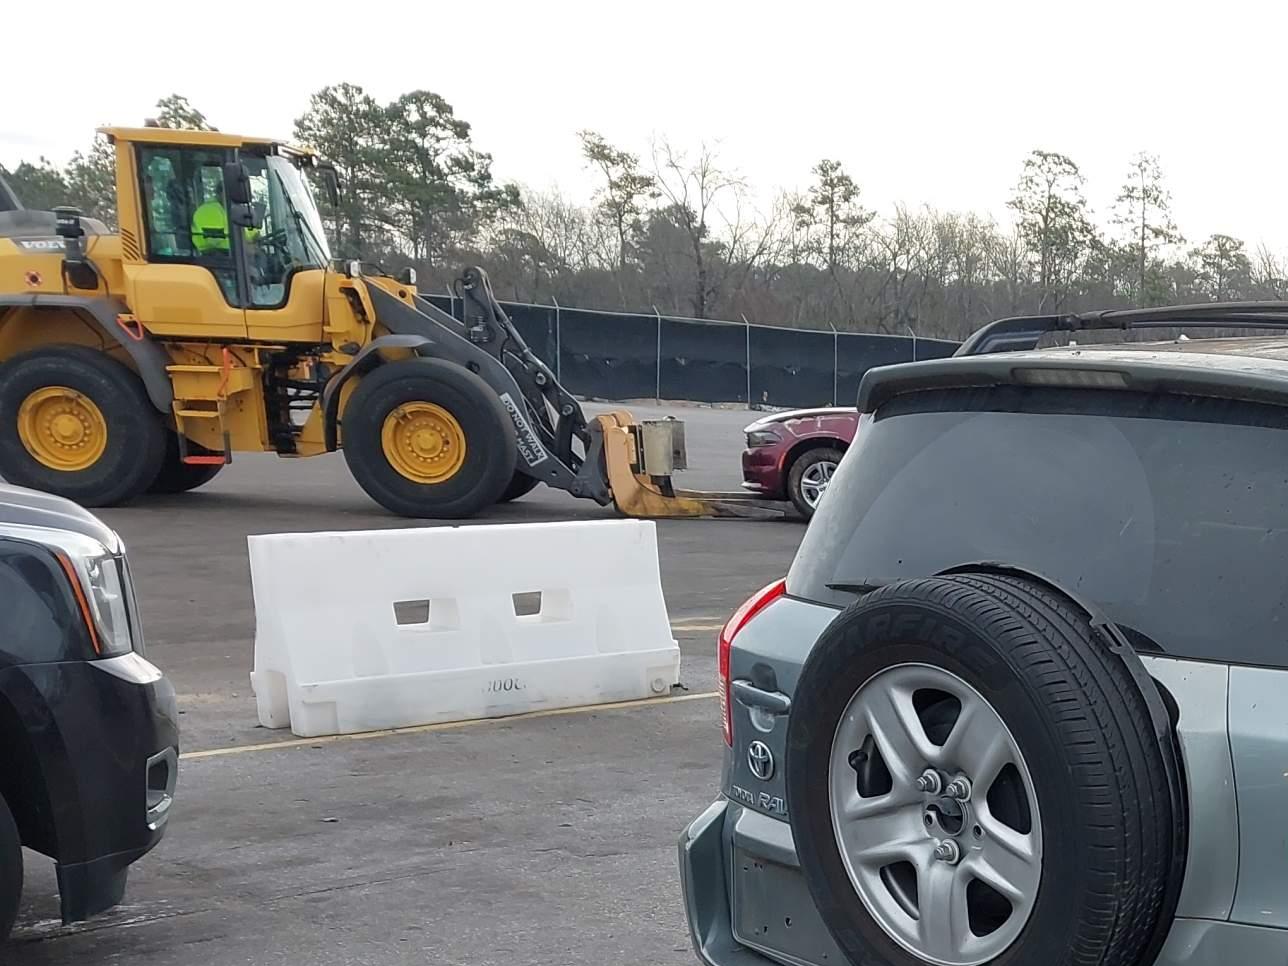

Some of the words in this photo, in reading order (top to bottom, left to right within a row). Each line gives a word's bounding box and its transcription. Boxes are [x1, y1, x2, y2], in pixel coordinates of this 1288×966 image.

[21, 240, 66, 249] VOLV
[512, 413, 529, 432] NOT
[526, 433, 544, 460] WALK
